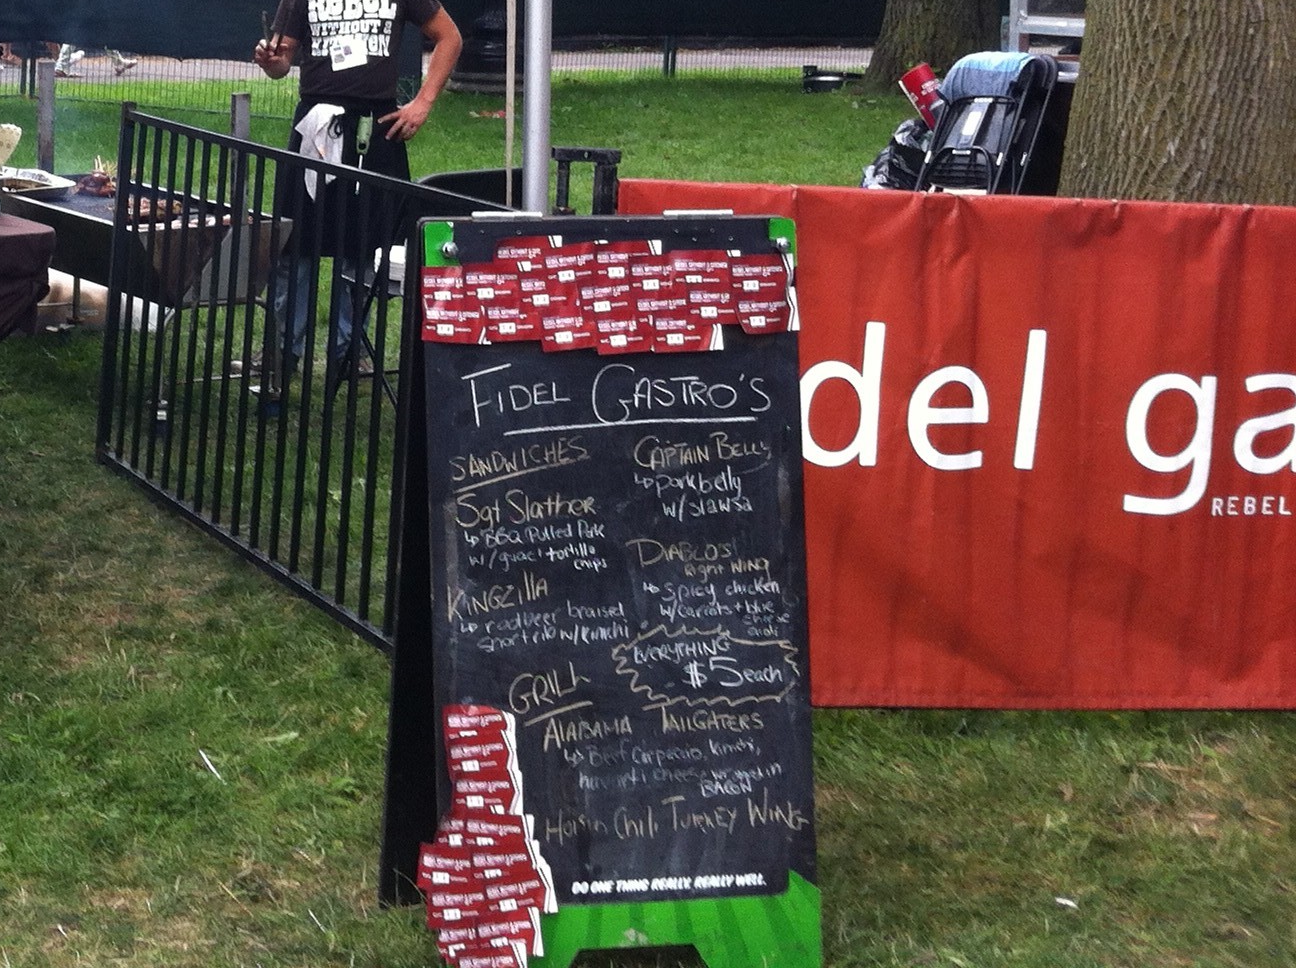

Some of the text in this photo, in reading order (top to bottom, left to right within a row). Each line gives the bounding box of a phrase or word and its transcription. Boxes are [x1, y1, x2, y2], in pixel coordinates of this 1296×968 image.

[310, 19, 382, 37] WITHOUT
[461, 362, 772, 428] FIDEL GASTRO'S
[449, 435, 591, 481] SANDWICHES
[633, 435, 710, 470] CAPTAIN
[455, 493, 501, 529] Sgt
[1211, 496, 1292, 517] REBEL
[509, 660, 591, 714] GRILL
[642, 700, 765, 734] TAILGATERS
